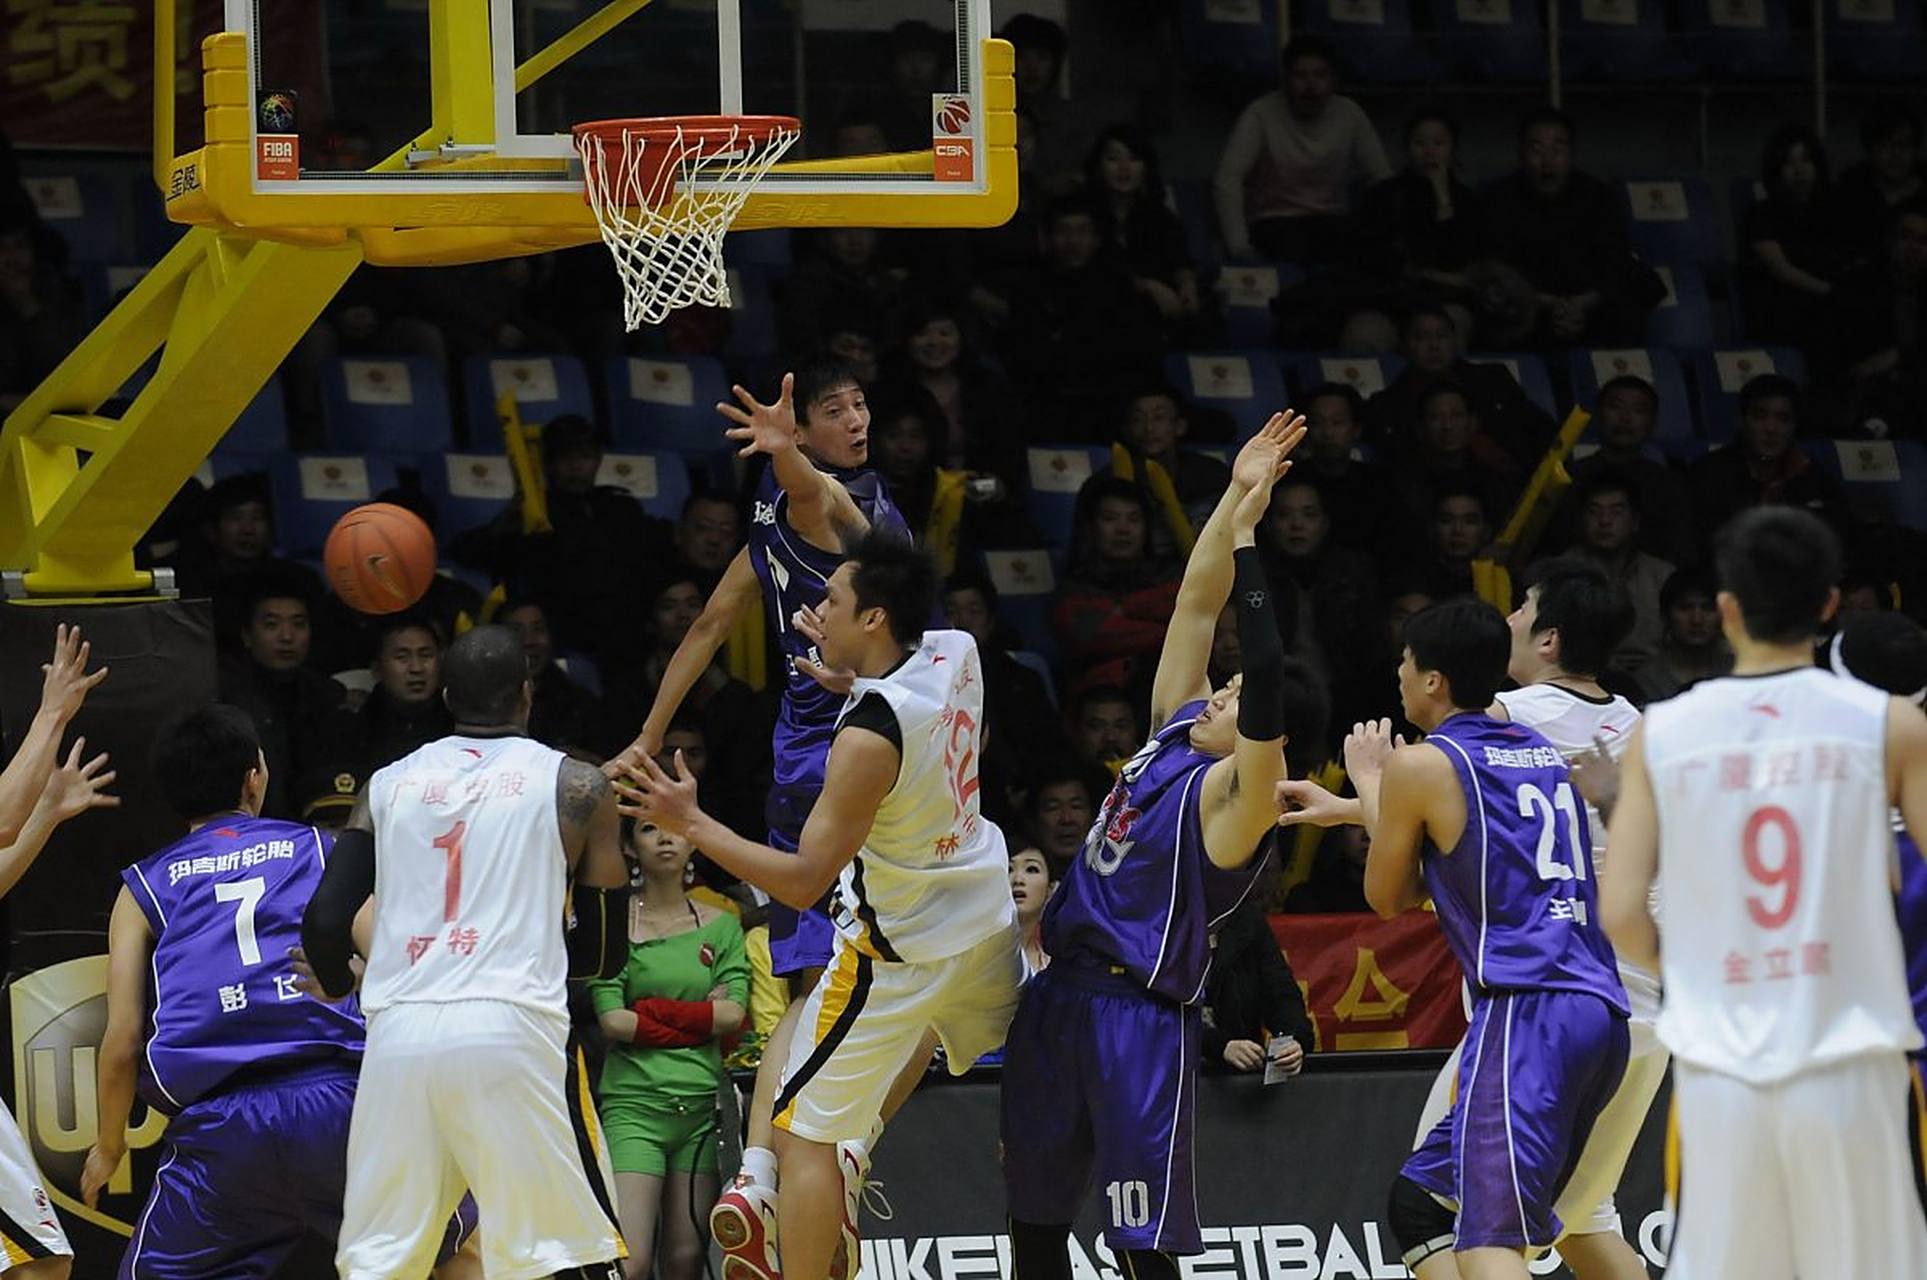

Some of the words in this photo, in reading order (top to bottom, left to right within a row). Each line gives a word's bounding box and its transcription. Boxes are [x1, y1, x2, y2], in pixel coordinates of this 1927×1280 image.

[263, 142, 292, 157] FIBA
[168, 840, 295, 887] 玛吉斯轮胎
[432, 820, 466, 923] 1
[1516, 783, 1587, 881] 21
[1741, 804, 1805, 931] 9
[214, 876, 266, 967] 7
[1106, 1180, 1150, 1228] 10
